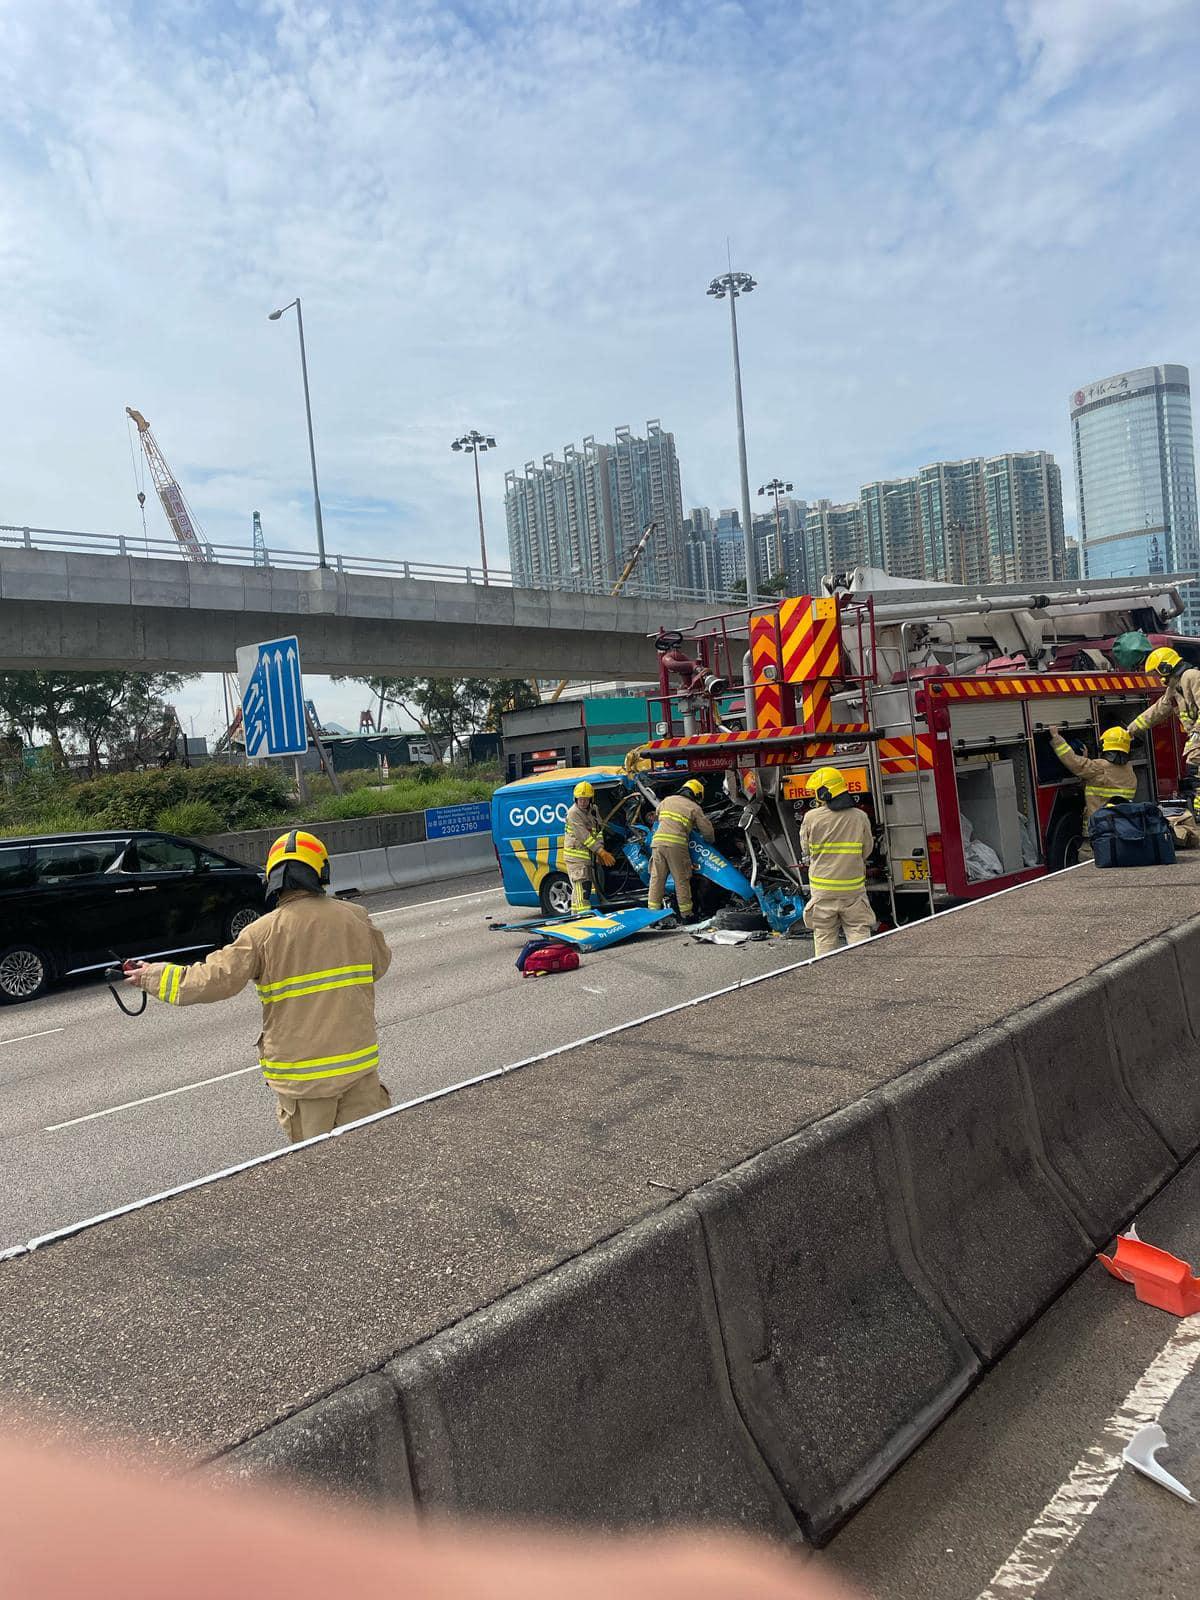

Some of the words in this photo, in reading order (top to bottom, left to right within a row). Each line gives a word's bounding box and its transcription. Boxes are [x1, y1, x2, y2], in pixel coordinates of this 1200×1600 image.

[441, 824, 460, 834] 2302
[461, 822, 478, 832] 5760
[688, 840, 728, 869] OGOVAN
